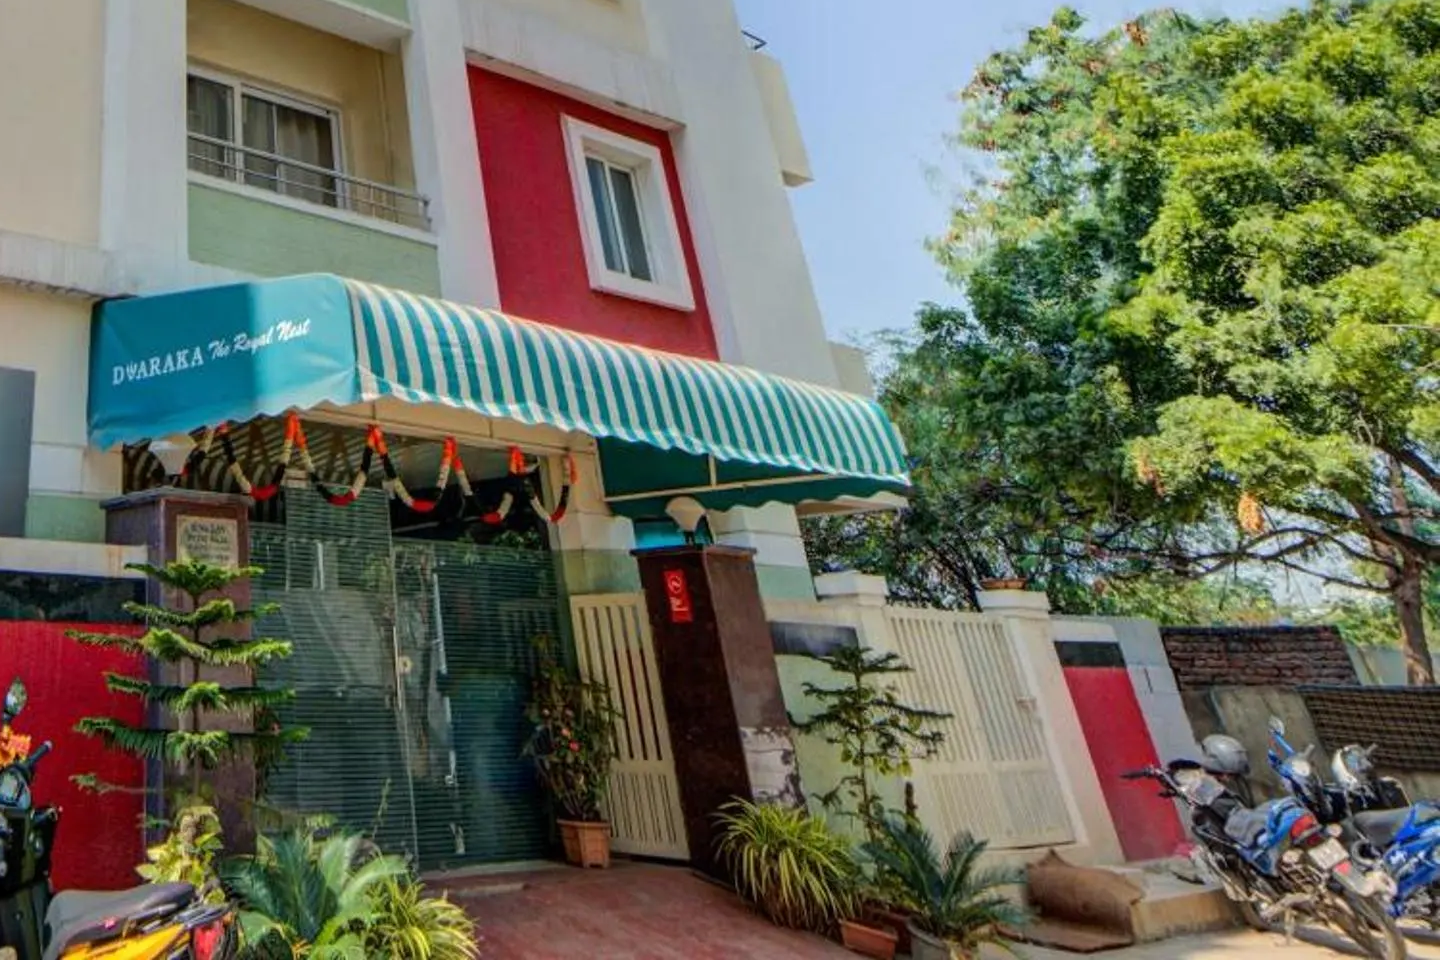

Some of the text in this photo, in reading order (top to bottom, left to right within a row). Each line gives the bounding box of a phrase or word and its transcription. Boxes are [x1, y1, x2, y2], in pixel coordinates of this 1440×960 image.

[112, 318, 310, 385] DWARAKA The Royal Nest
